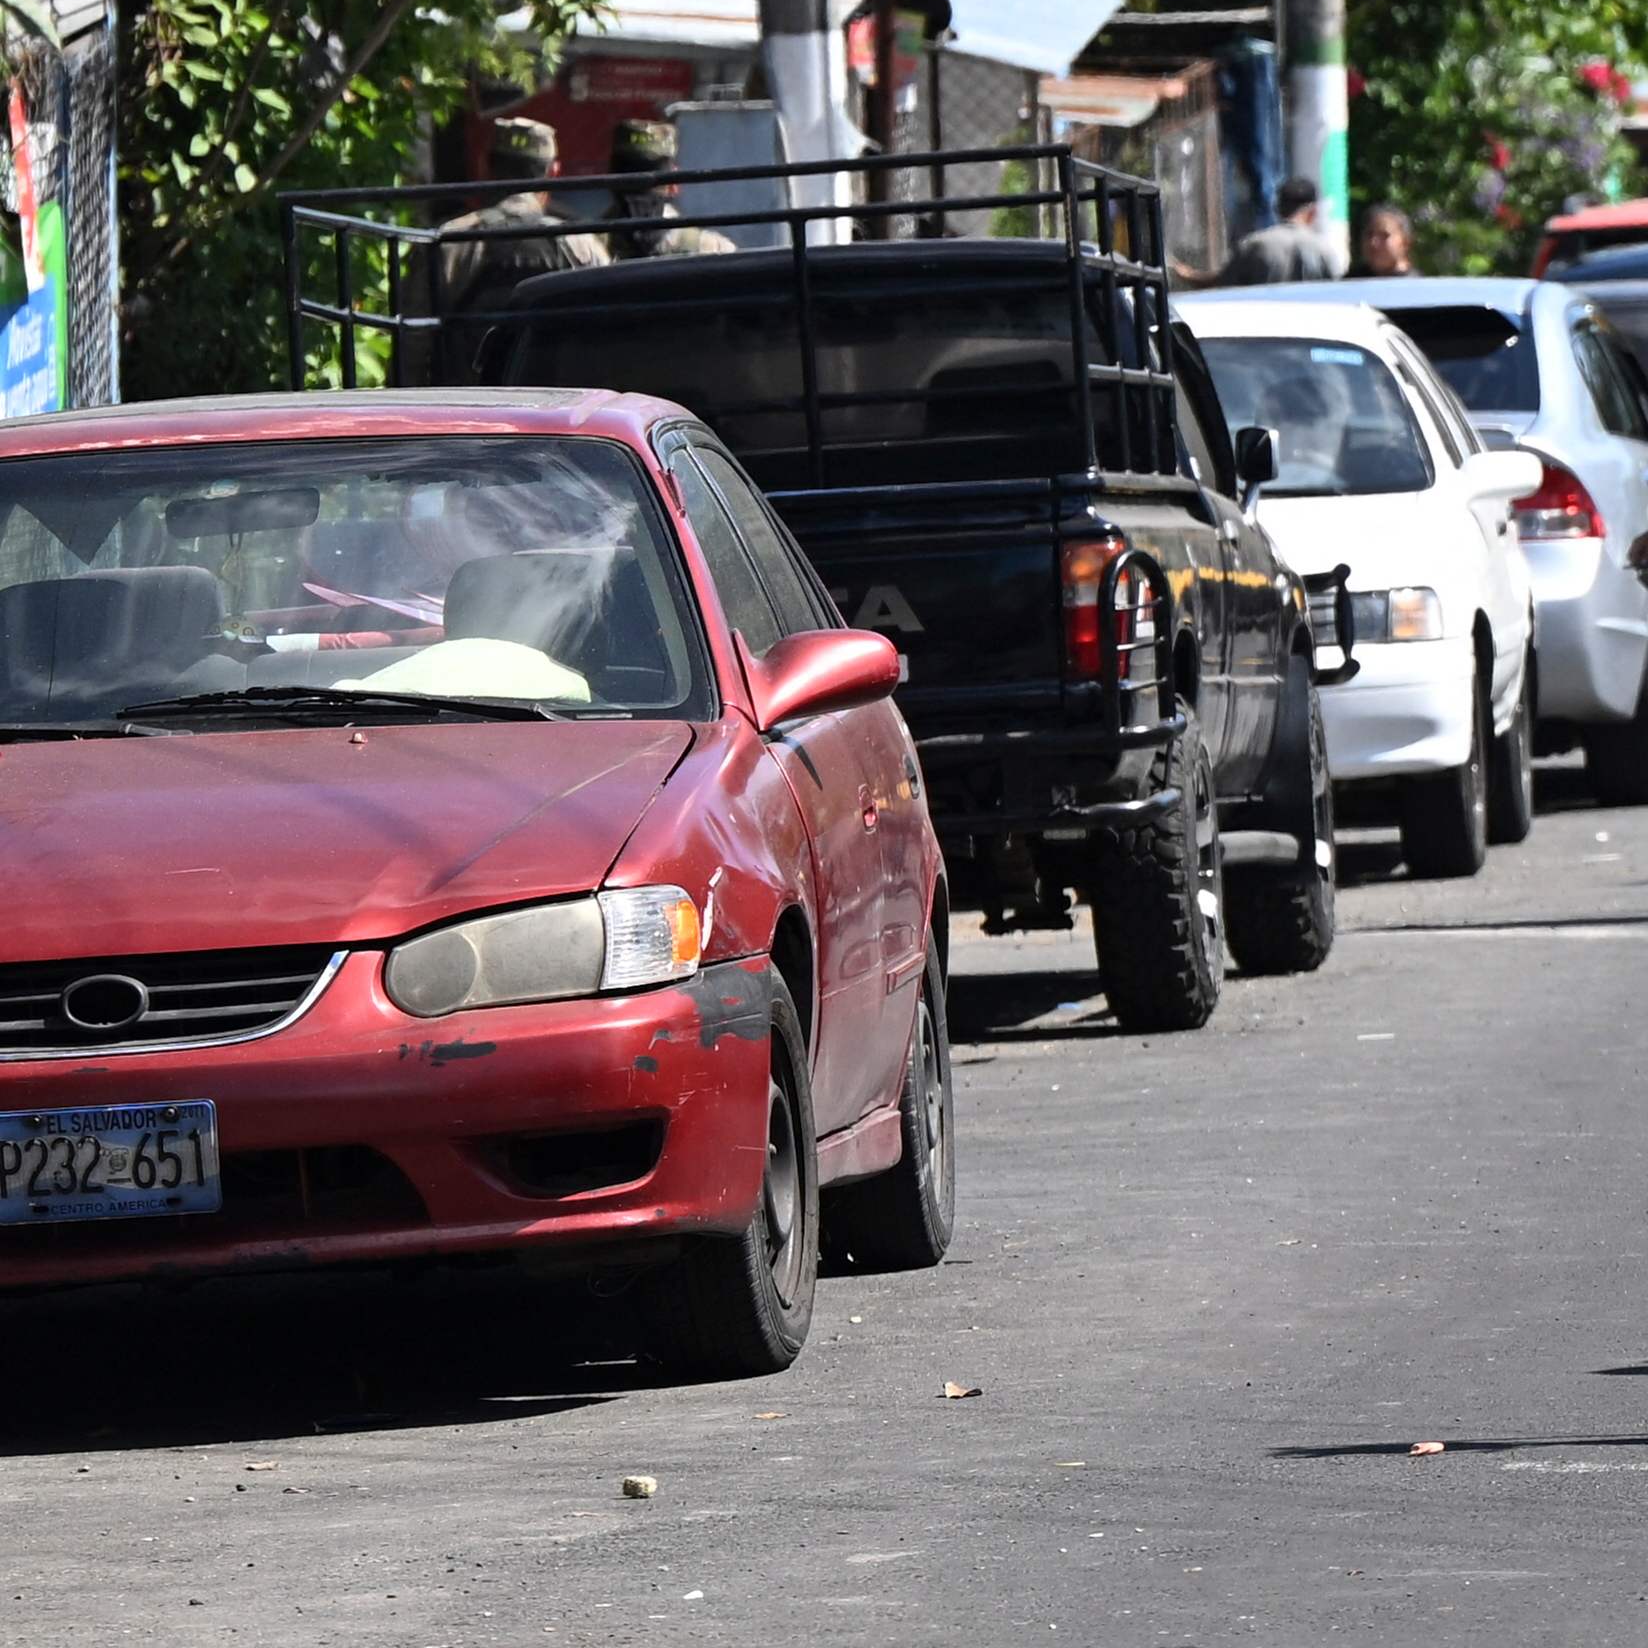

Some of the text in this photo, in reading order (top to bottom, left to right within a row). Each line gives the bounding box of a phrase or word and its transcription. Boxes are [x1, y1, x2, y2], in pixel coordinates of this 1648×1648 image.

[48, 1118, 63, 1134] EL
[71, 1109, 157, 1132] SALVADOR
[0, 1128, 206, 1199] P232-651
[51, 1199, 167, 1216] CENTRO AMERICA
